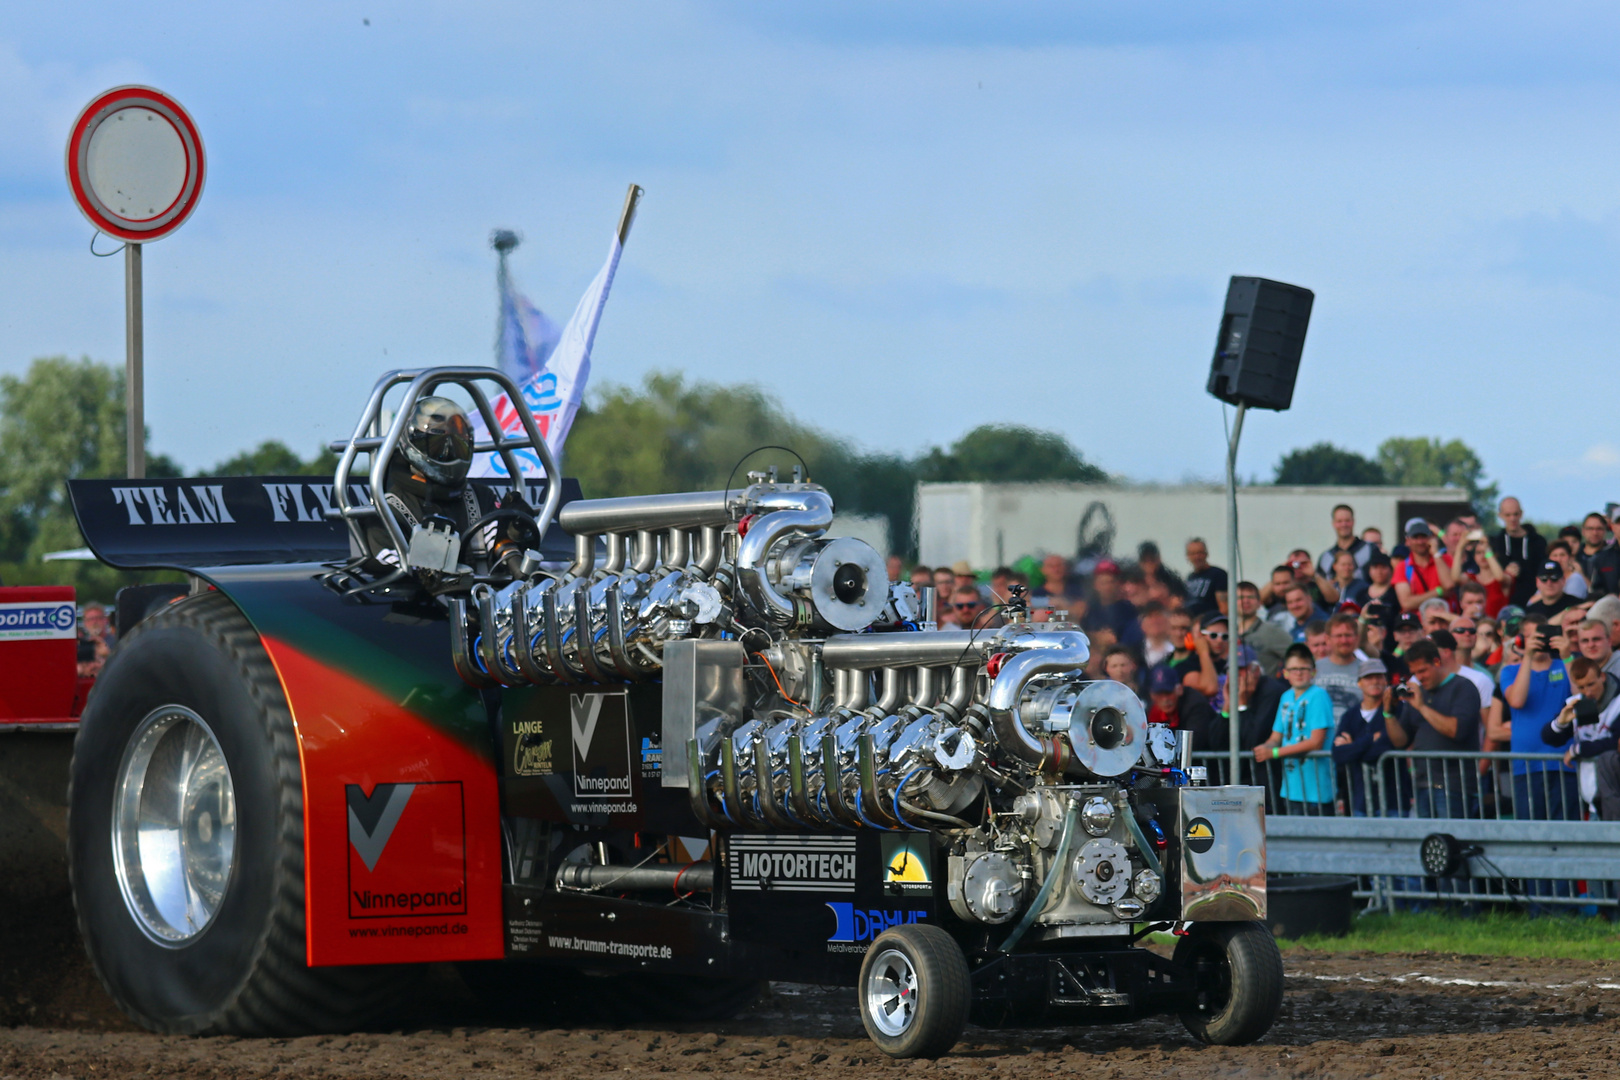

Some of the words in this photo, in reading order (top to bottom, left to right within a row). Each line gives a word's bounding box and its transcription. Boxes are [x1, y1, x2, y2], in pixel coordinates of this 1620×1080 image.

[111, 485, 236, 525] TEAM
[261, 483, 372, 524] FLYN
[513, 721, 543, 734] LANGE
[642, 737, 662, 750] BR
[576, 774, 629, 793] Vinnepand
[570, 802, 638, 815] www.vinnepand.de
[743, 853, 856, 879] MOTORTECH
[353, 887, 462, 911] Vinnepand
[348, 922, 469, 938] www.vinnepand.de
[548, 935, 672, 959] www.brumm-transporte.de
